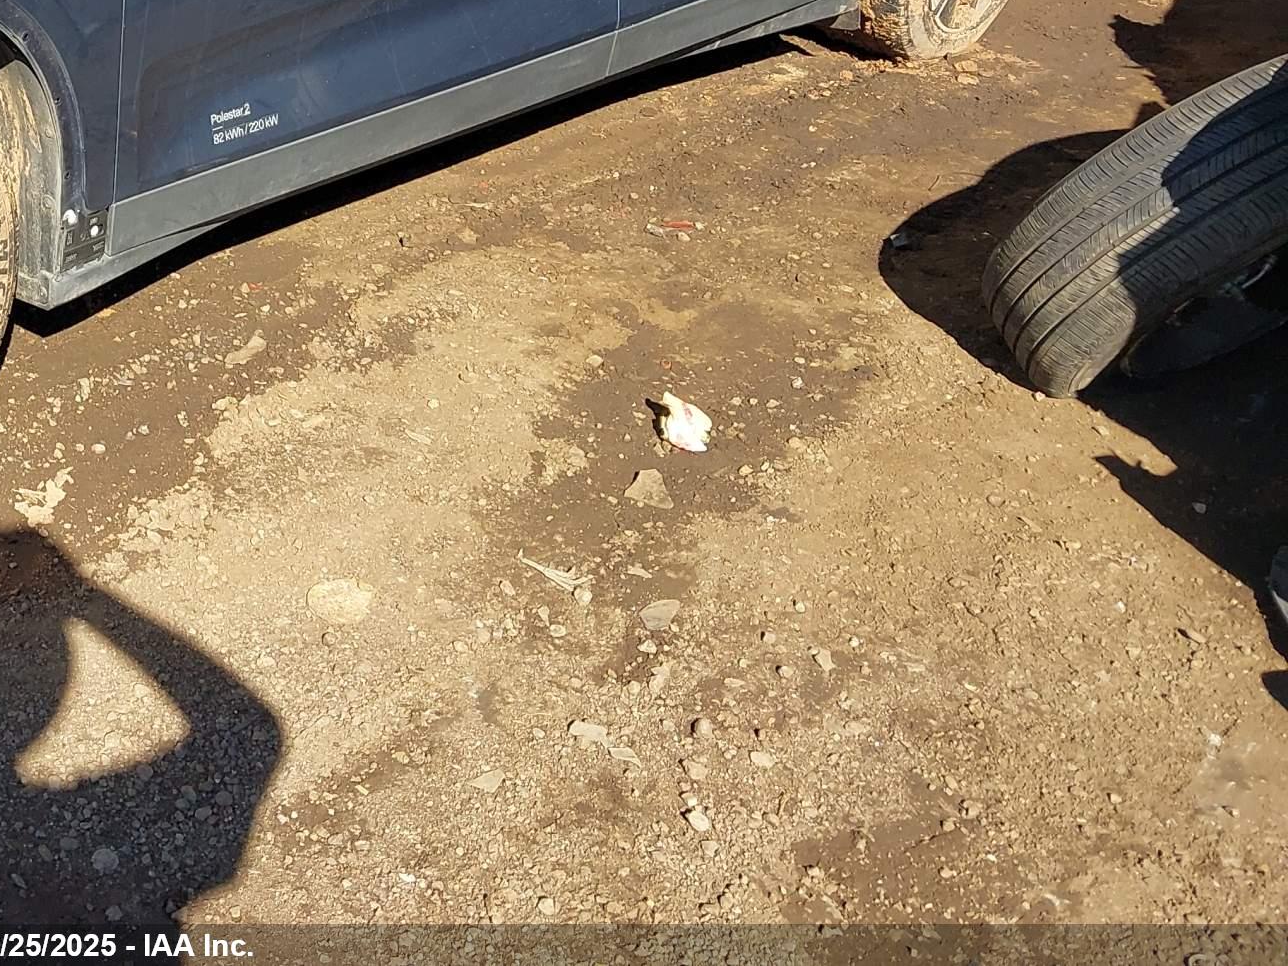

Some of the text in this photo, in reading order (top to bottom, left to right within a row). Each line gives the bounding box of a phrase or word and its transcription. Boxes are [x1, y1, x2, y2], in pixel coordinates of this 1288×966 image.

[210, 102, 251, 126] Polestar 2
[213, 132, 224, 145] 82
[224, 126, 245, 142] kWh
[248, 119, 264, 133] 220
[265, 113, 279, 128] kW
